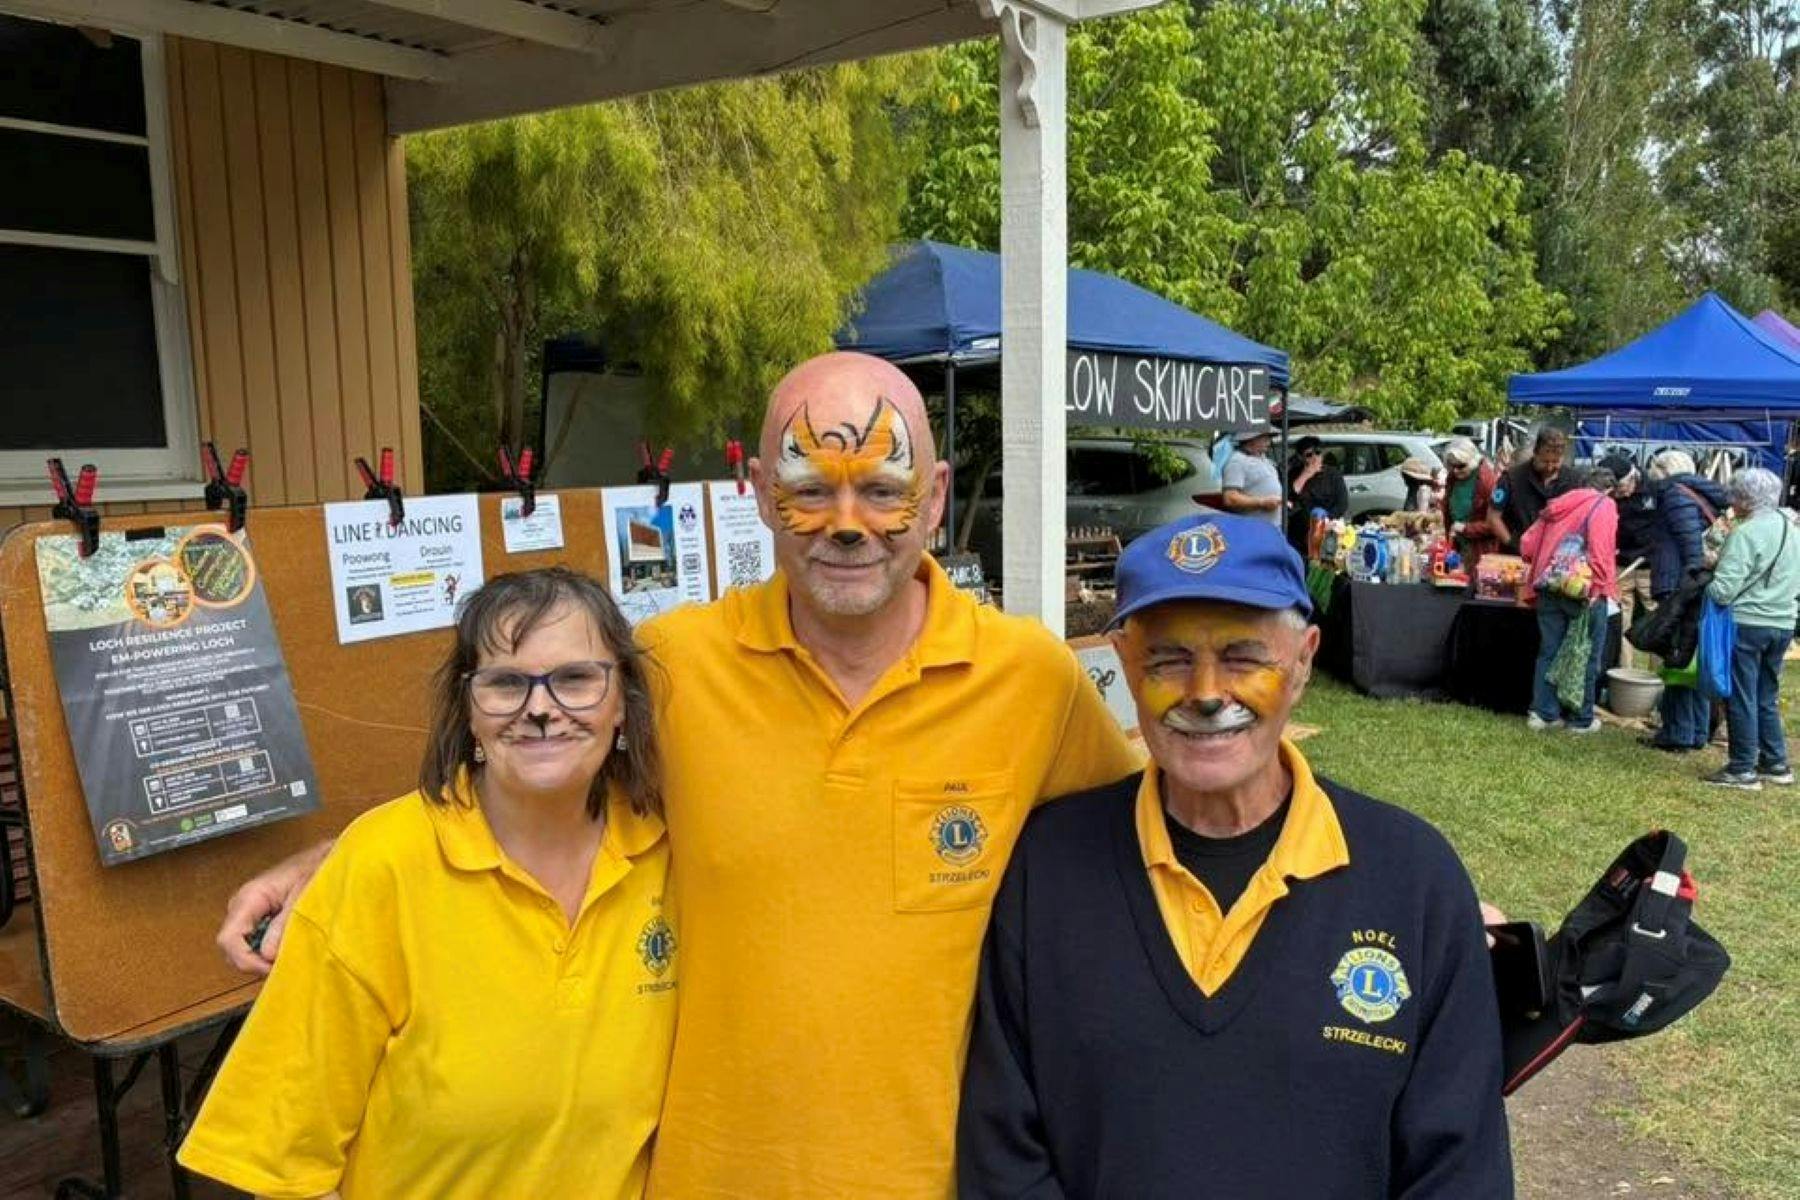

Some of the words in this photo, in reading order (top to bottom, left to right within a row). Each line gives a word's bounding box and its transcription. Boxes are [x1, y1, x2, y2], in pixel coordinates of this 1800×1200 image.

[1133, 357, 1266, 424] SKINCARE
[334, 522, 372, 544] LINE
[386, 515, 464, 539] DANCING
[342, 552, 391, 566] Poowong
[1190, 535, 1208, 555] L
[89, 638, 124, 652] LOCH
[126, 627, 193, 646] RESILIENCE
[195, 619, 247, 636] PROJECT
[111, 642, 199, 665] EM-POWERING
[202, 636, 235, 650] LOCH
[944, 781, 968, 792] PAUL
[952, 823, 968, 846] L
[1351, 929, 1396, 949] NOEL
[1363, 969, 1383, 997] L
[1322, 1026, 1407, 1055] STRZELECKI
